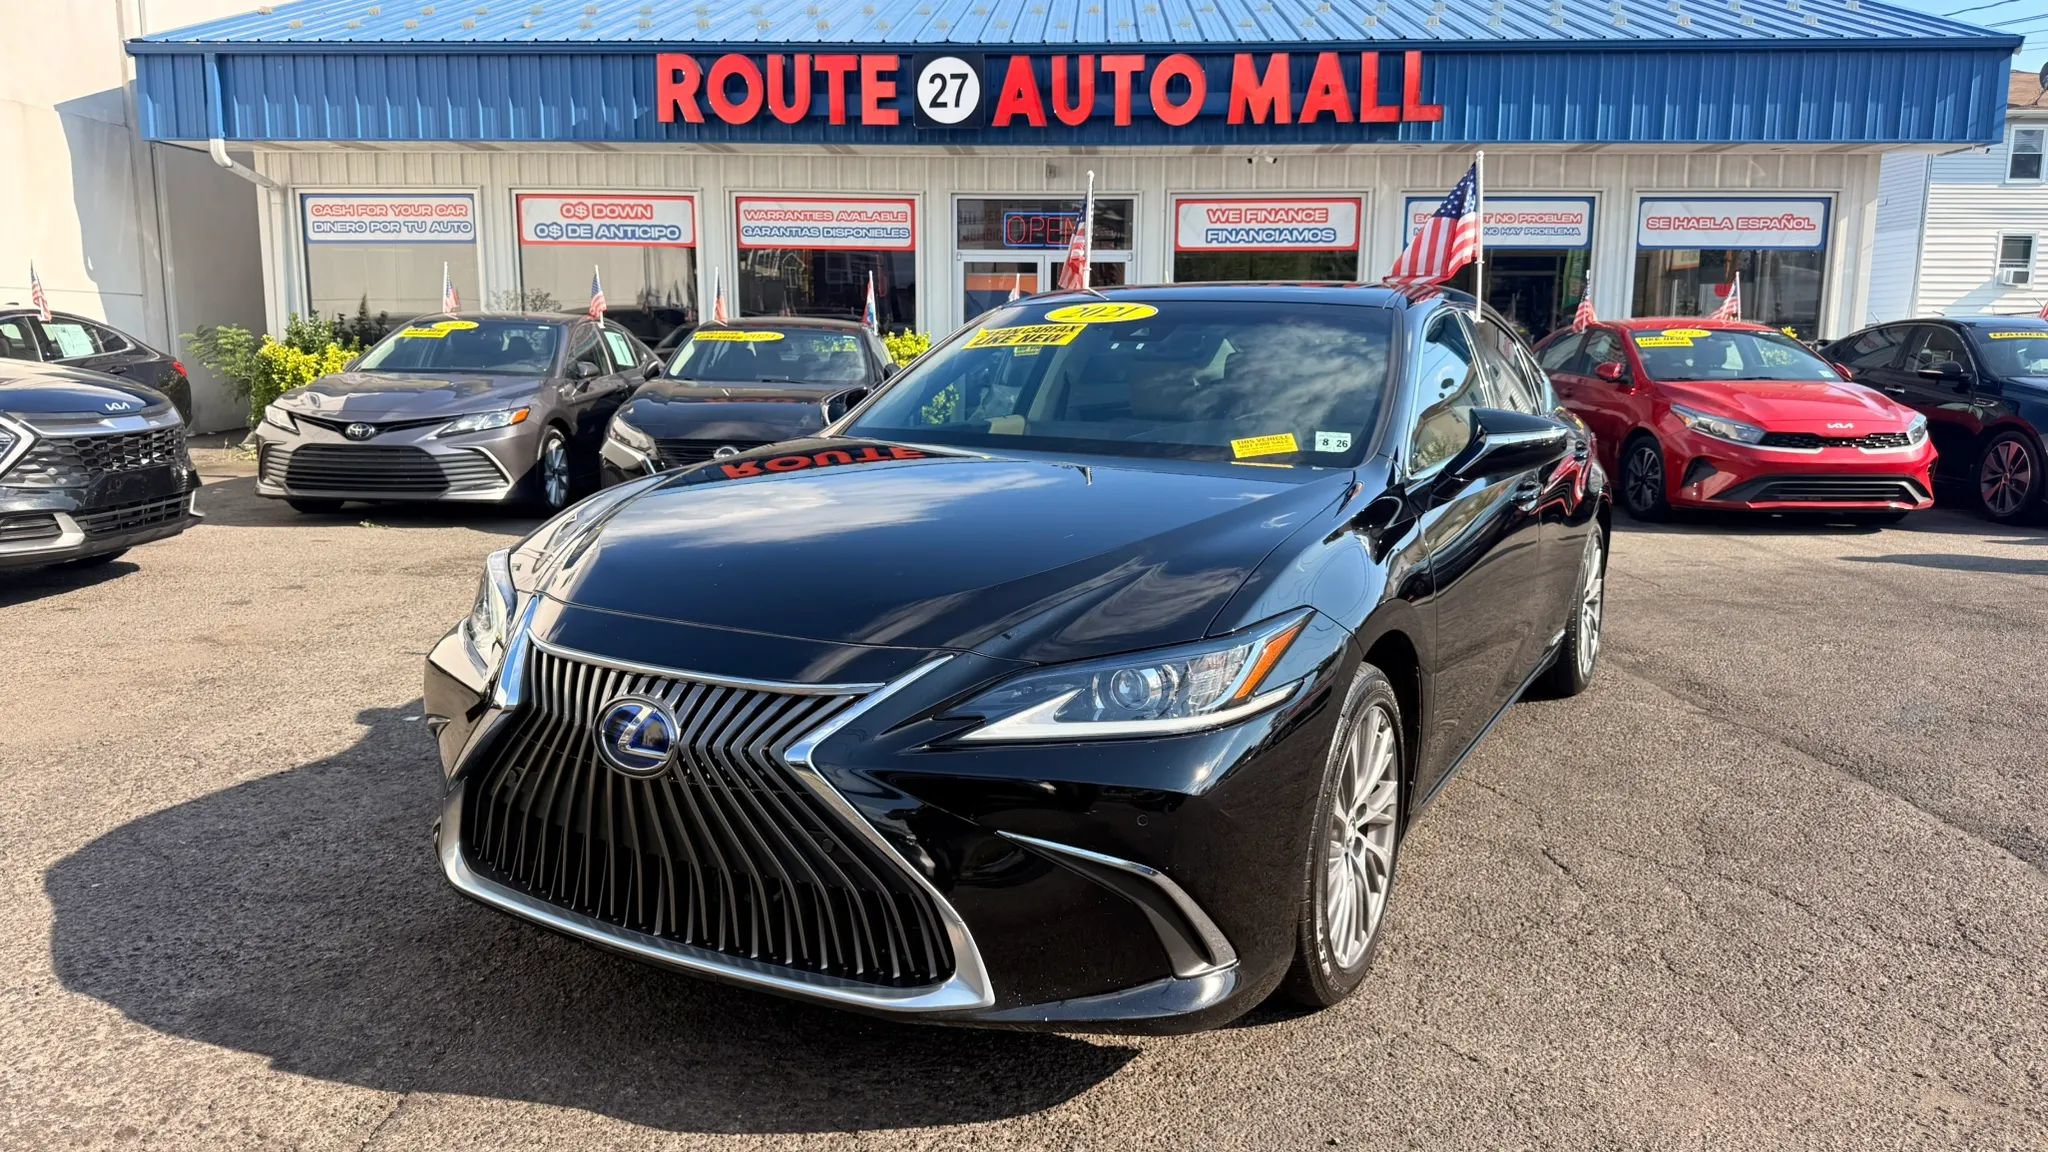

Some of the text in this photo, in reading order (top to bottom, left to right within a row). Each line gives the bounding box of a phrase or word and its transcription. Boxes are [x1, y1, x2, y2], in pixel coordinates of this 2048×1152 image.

[657, 51, 1443, 127] ROUTE 27 AUTO MALL
[312, 204, 468, 217] CASH FOR YOUR CAR
[592, 203, 653, 219] DOWN
[744, 209, 907, 223] WARRANTIES AVAILABLE
[1207, 207, 1329, 224] WE FINANCE
[1494, 213, 1516, 224] NO
[1517, 213, 1582, 224] PROBLEM
[1647, 213, 1816, 231] SE HABLA ESPAÑOL
[313, 220, 473, 233] DINERO POR TU AUTO
[566, 224, 593, 239] DE
[595, 224, 681, 241] ANTICIPO
[742, 226, 910, 239] GARANTIAS DISPONIBLES
[1007, 216, 1077, 243] OPEN
[1484, 227, 1581, 236] NO HAY PROBLEMA
[1206, 227, 1336, 244] FINANCIAMOS
[1061, 306, 1141, 319] 2021
[1021, 325, 1078, 335] CARFAX
[1015, 333, 1066, 344] NEW
[1322, 439, 1348, 448] 8 26
